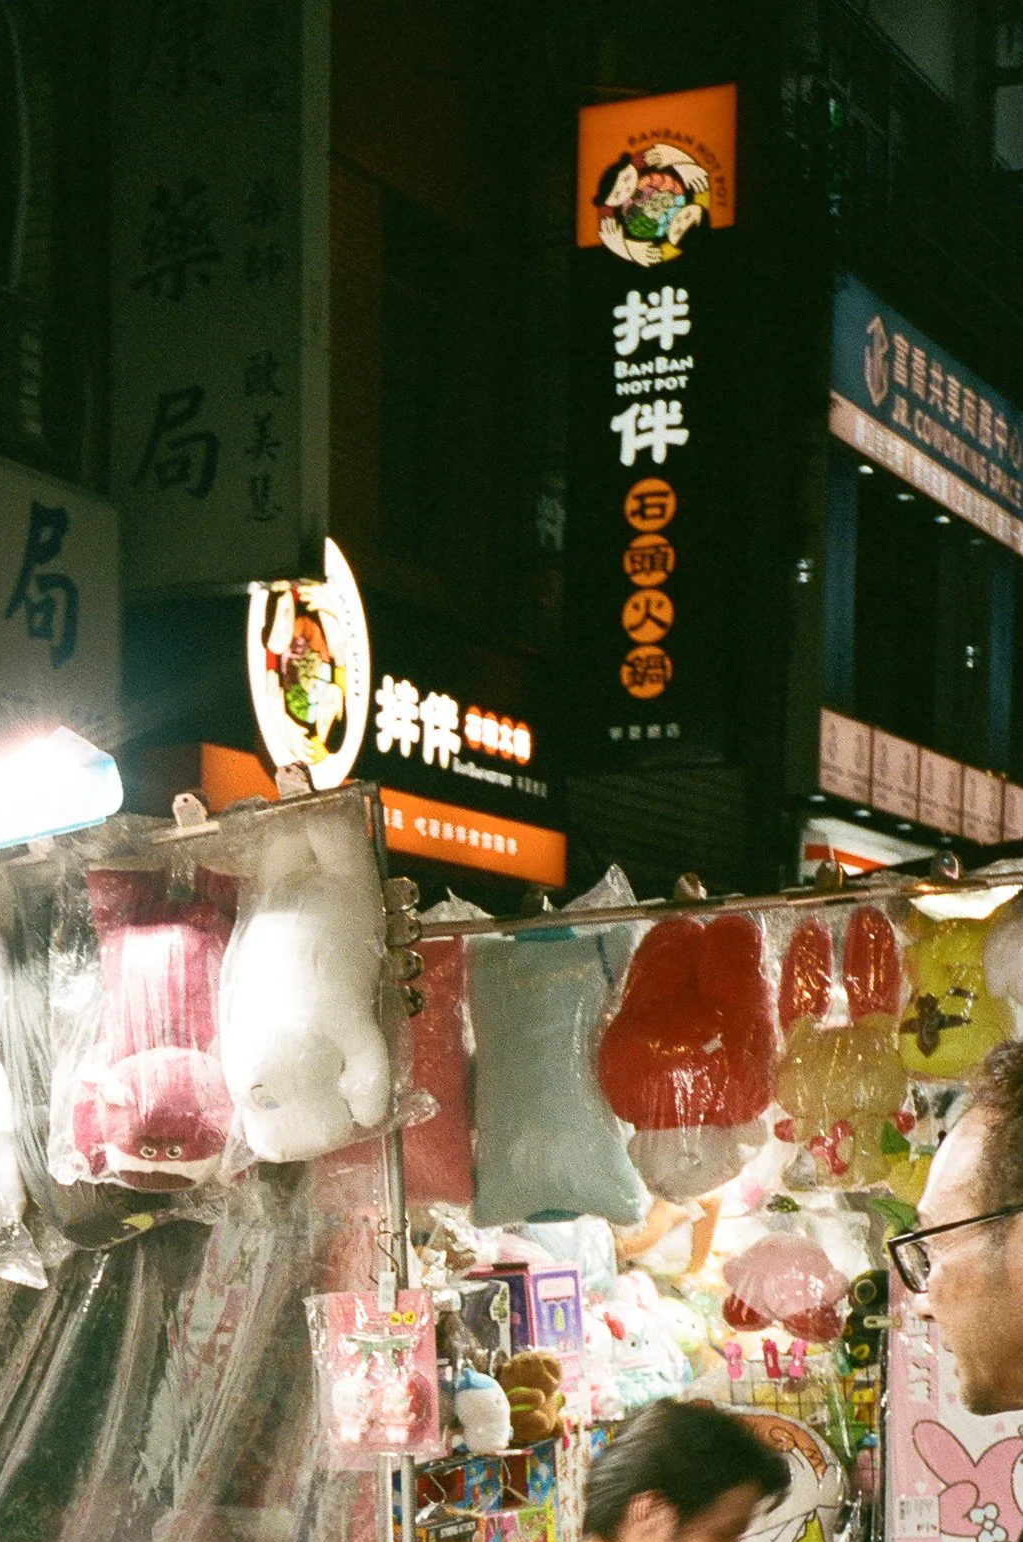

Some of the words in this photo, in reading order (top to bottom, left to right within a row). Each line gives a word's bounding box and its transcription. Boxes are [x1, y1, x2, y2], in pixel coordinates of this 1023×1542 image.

[612, 286, 692, 356] 拌
[616, 378, 652, 396] HOT
[653, 375, 689, 393] POT
[610, 400, 690, 467] 伴
[621, 487, 675, 693] 石頭火鍋
